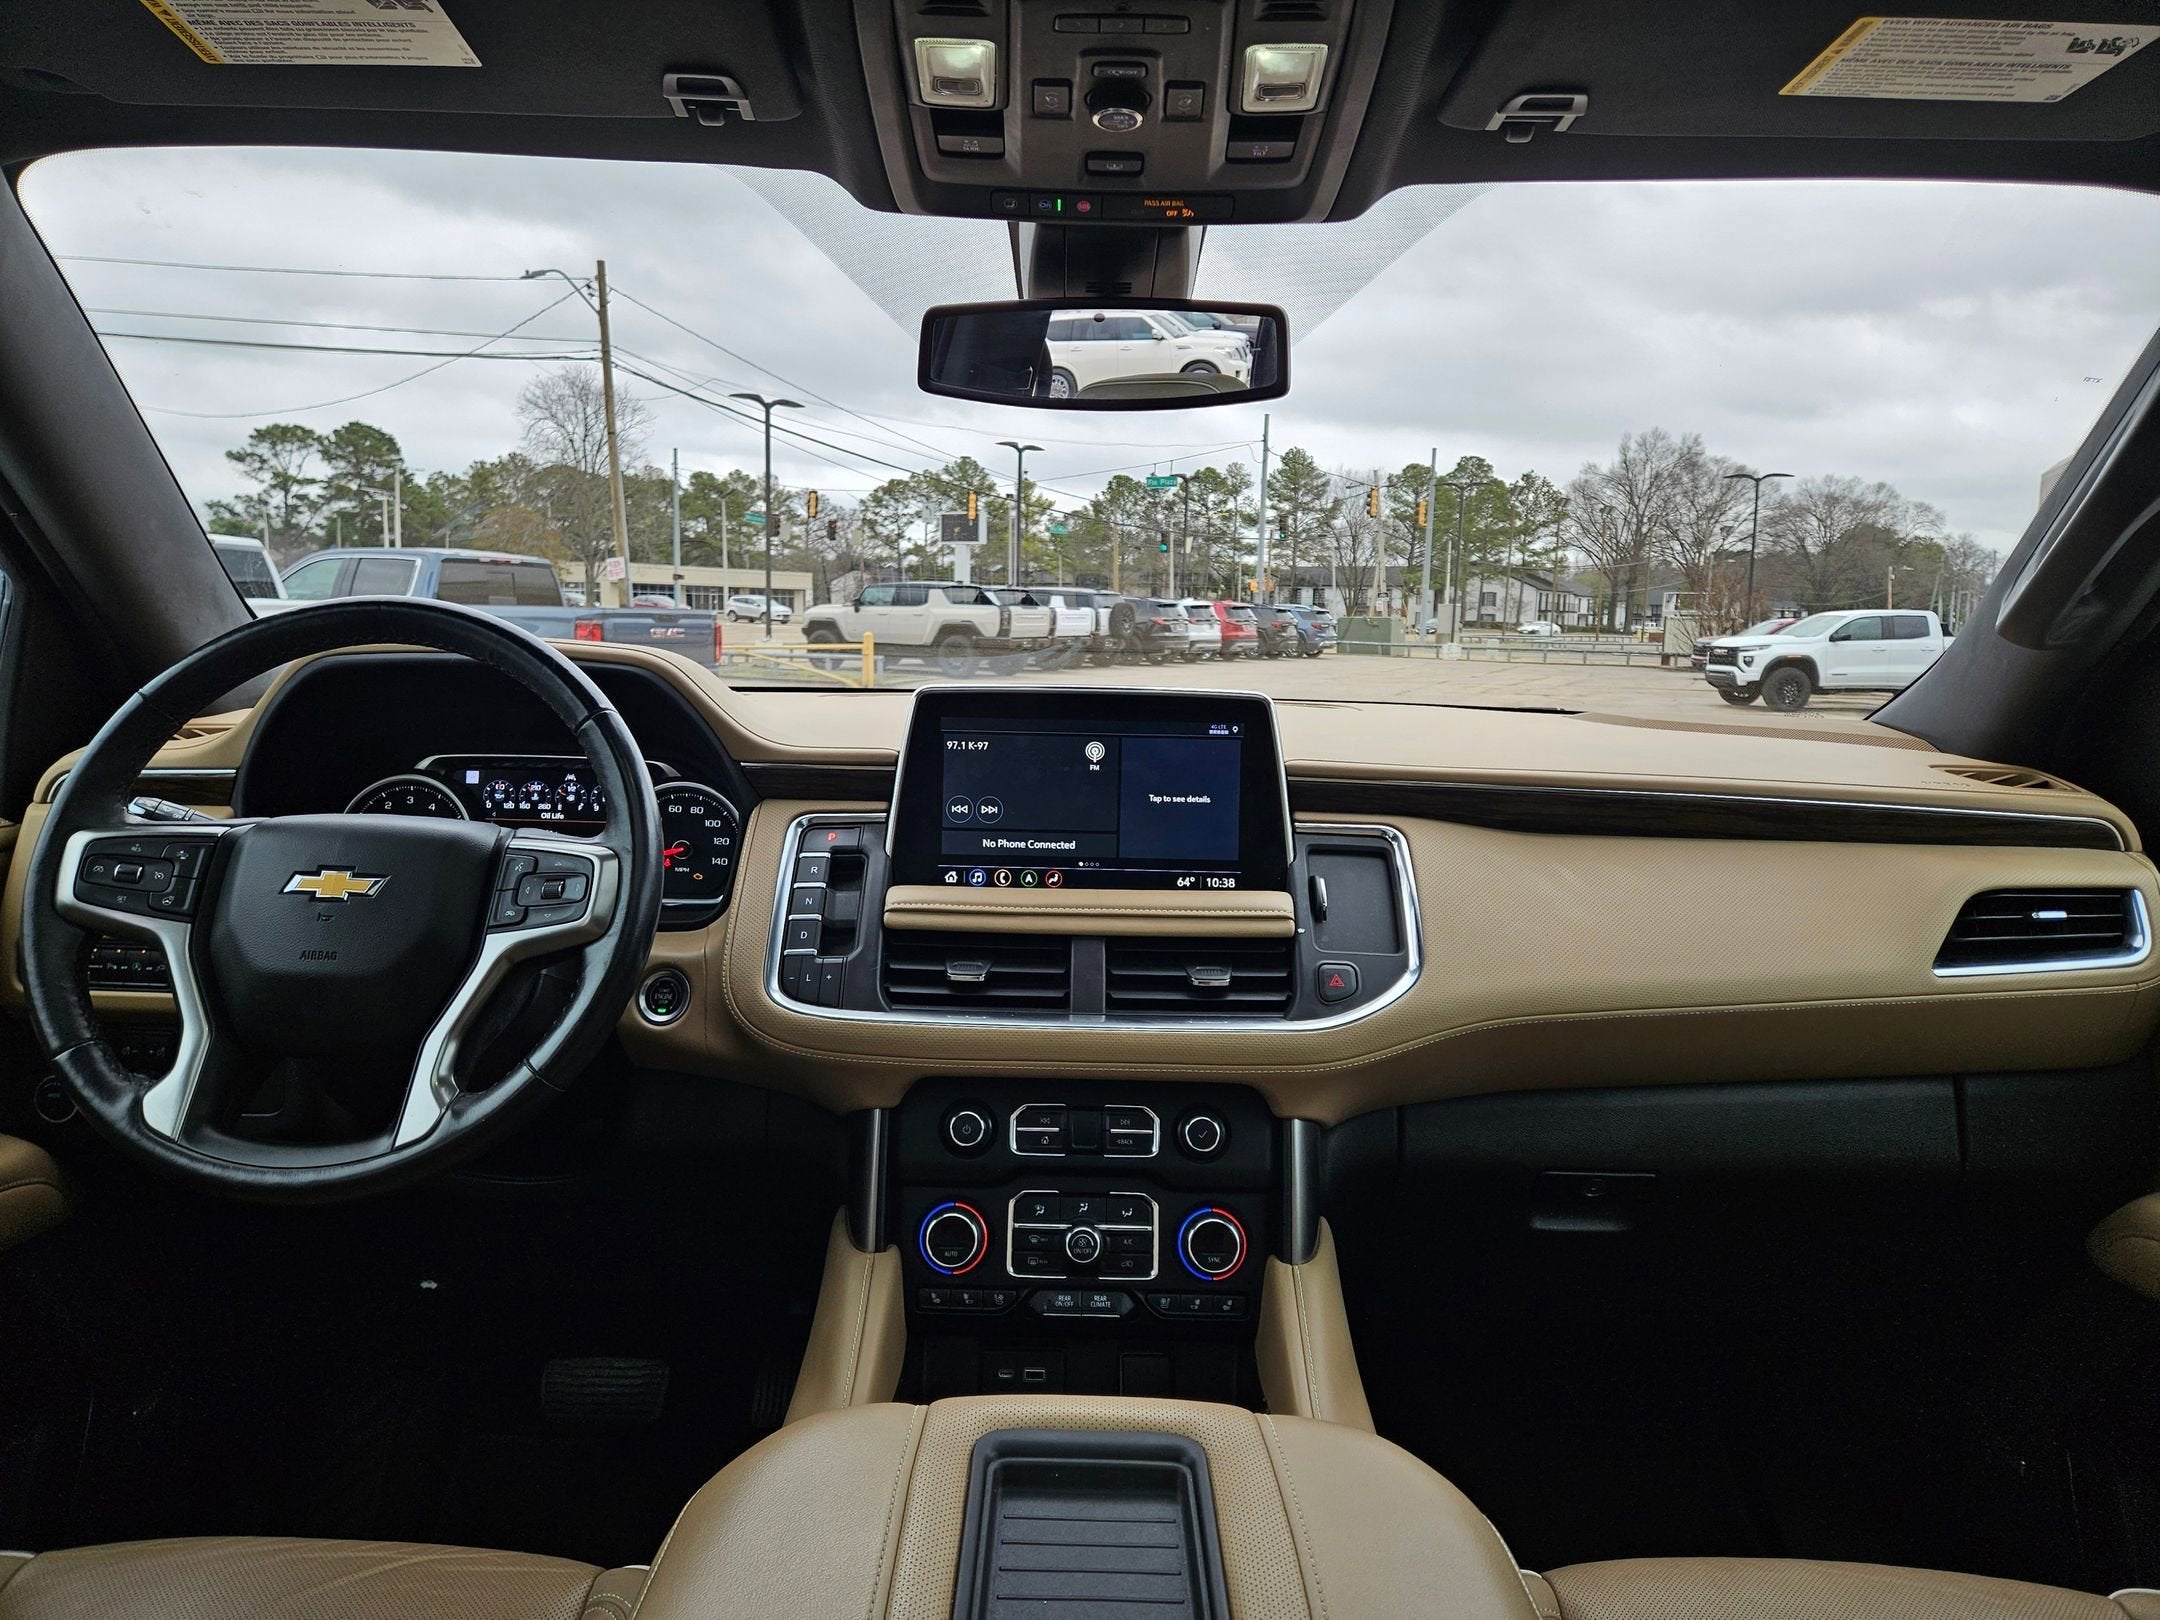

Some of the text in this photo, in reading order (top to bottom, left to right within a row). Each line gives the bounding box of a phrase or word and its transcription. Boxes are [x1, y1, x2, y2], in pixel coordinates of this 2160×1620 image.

[1160, 478, 1177, 486] Plaza
[946, 740, 989, 751] 97.1 K-97
[406, 795, 414, 805] 3
[1148, 794, 1163, 804] Tap
[1163, 795, 1172, 803] to
[1186, 795, 1212, 804] details
[384, 801, 392, 810] 2
[428, 803, 436, 811] 4
[668, 804, 683, 813] 60
[689, 806, 704, 815] 80
[540, 812, 565, 820] Oil Life
[704, 819, 721, 828] 100
[827, 832, 836, 841] P
[713, 837, 730, 846] 120
[982, 838, 1076, 850] No Phone Connected
[711, 857, 728, 866] 140
[810, 866, 818, 874] R
[1176, 876, 1195, 888] 64°
[1206, 877, 1236, 889] 10:38
[805, 897, 813, 905] N
[800, 931, 808, 939] D
[300, 950, 338, 961] AIRBAG
[805, 973, 811, 982] L
[1073, 1247, 1092, 1255] ON/OFF
[1057, 1294, 1072, 1302] REAR
[1093, 1294, 1107, 1302] REAR
[1054, 1300, 1074, 1308] ON/OFF
[1090, 1300, 1111, 1309] CLIMATE
